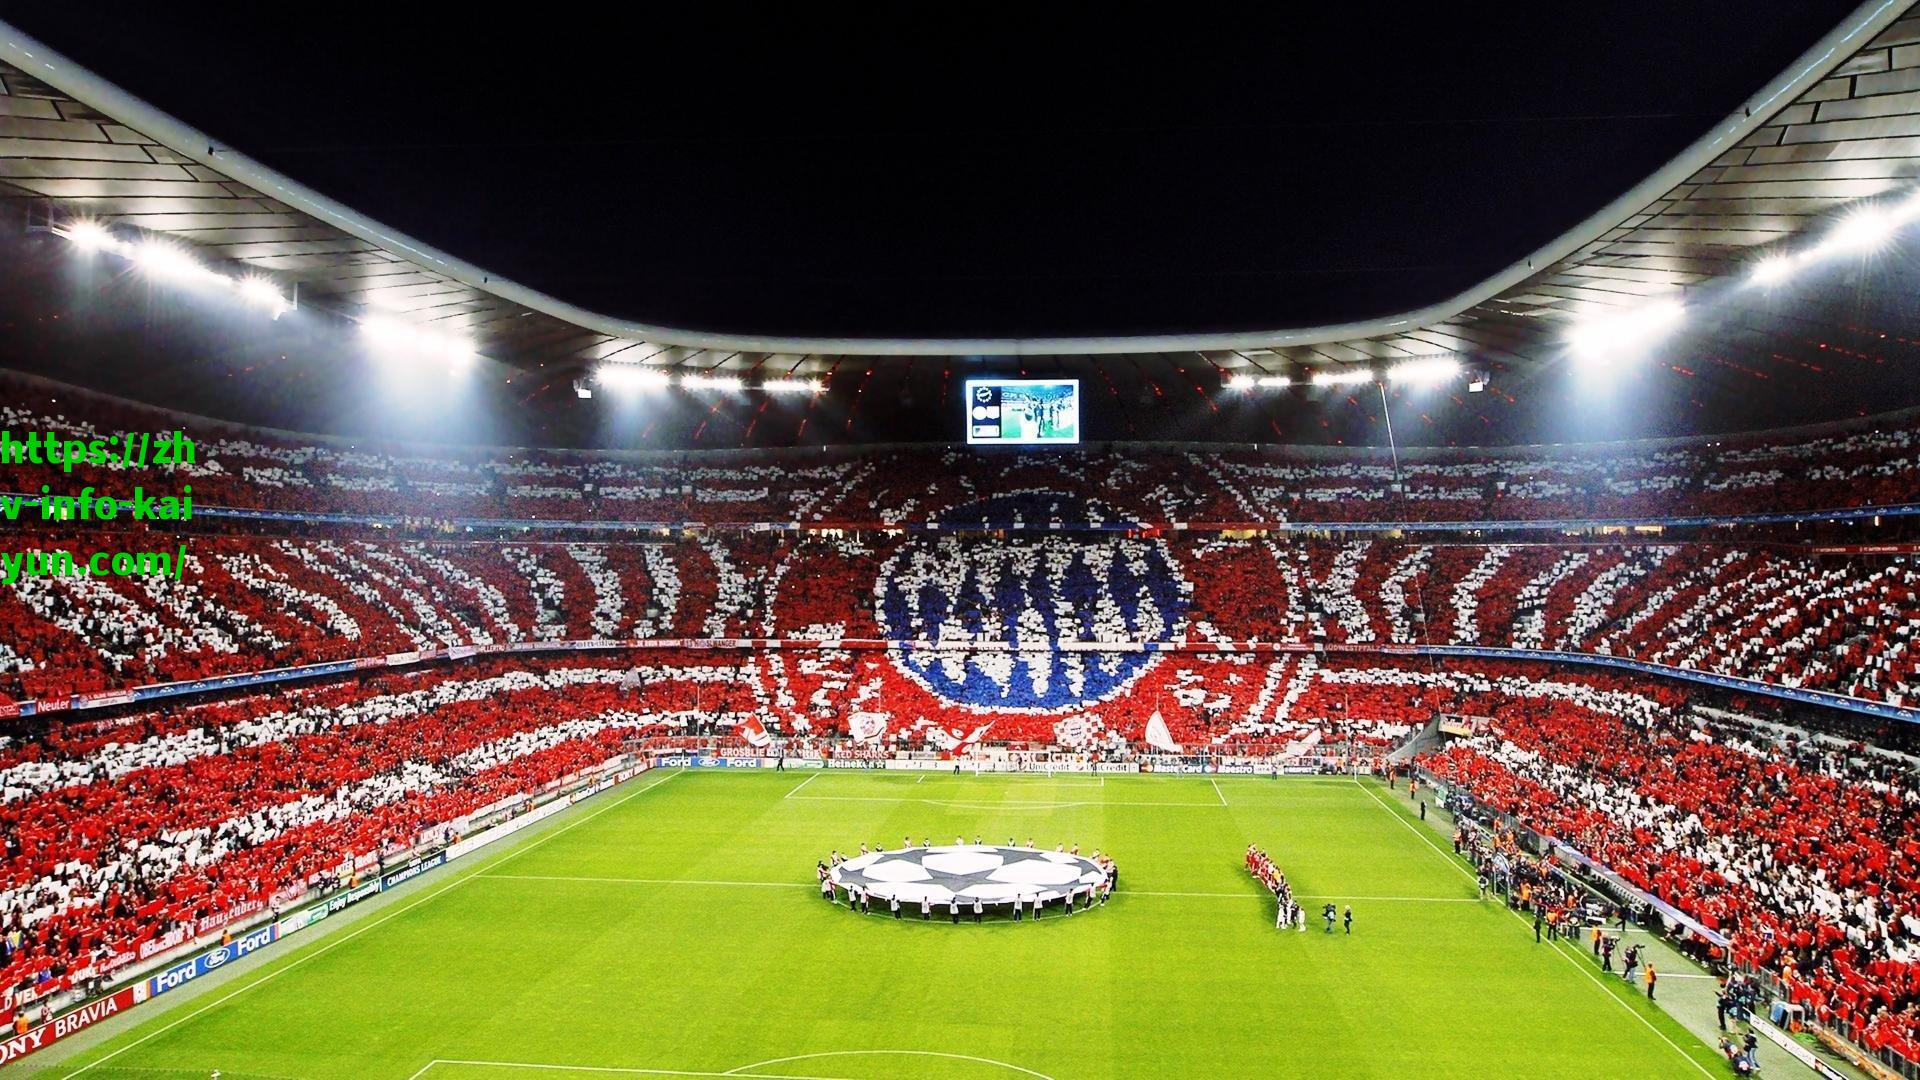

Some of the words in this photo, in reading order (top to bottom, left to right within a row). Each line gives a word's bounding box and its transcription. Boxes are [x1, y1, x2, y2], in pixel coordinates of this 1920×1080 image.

[661, 757, 691, 767] Ford
[726, 757, 756, 767] Ford
[1086, 763, 1127, 771] UiCredit
[1154, 764, 1202, 773] MasteCard
[1217, 764, 1253, 774] Maestro
[386, 865, 421, 887] CHAMPIONS
[421, 856, 442, 871] LEAGUE
[329, 896, 347, 911] Enjoy
[237, 928, 271, 956] Ford
[156, 968, 197, 993] Ford
[54, 997, 118, 1039] BRAVIA
